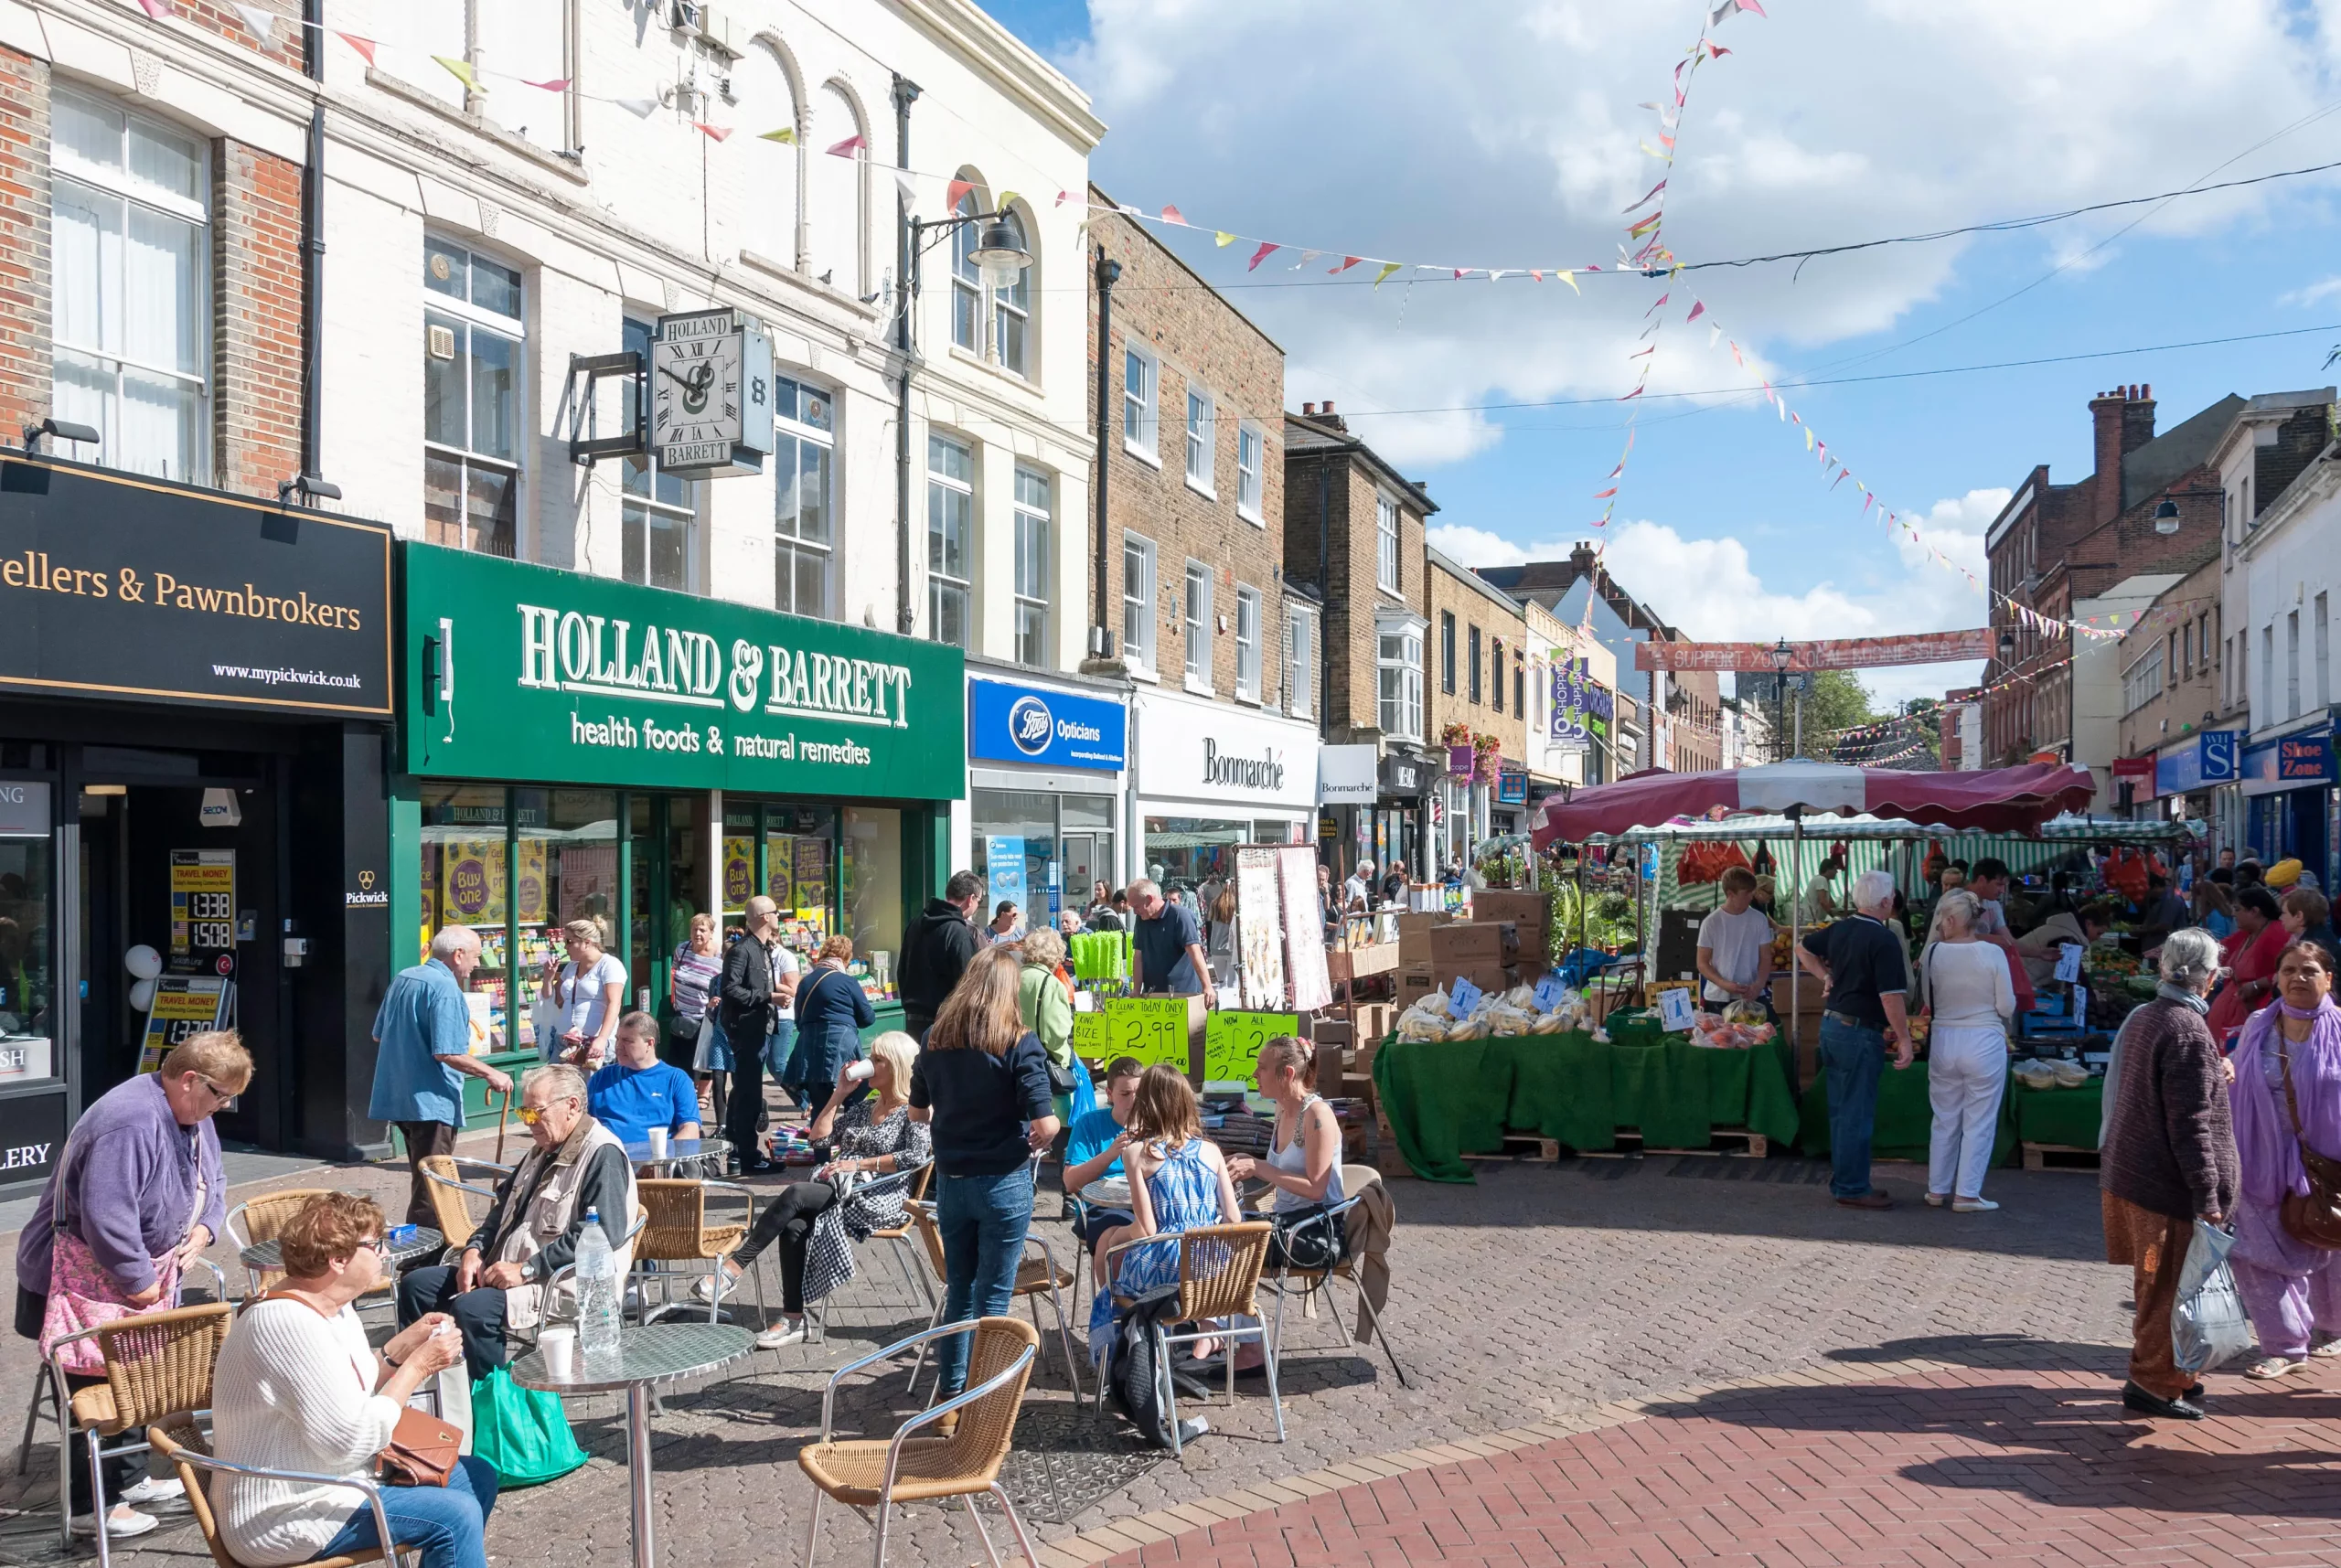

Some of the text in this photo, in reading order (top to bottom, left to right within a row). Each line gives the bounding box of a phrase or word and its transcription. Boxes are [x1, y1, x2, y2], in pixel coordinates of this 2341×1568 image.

[668, 317, 727, 341] HOLLAND
[668, 442, 727, 465] BARRETT
[0, 550, 361, 632] ellers & Pawnbrokers
[1673, 640, 1951, 669] SUPPORT YO LOCAL BUSINESSES
[517, 603, 913, 730] HOLLAND & BARRETT
[212, 663, 362, 689] www.mypickwick.co.uk
[1020, 709, 1100, 741] Boots Opticians
[570, 711, 871, 765] health foods & natural remedies
[2206, 733, 2228, 744] WH
[2282, 741, 2322, 758] Shoe
[1203, 737, 1285, 791] Bonmarché
[1450, 763, 1469, 772] cope
[2206, 743, 2230, 777] S
[2282, 759, 2322, 777] Zone
[1322, 783, 1373, 793] Bonmarché
[454, 806, 491, 822] HOLLAND
[726, 814, 753, 826] HOLLAND
[176, 869, 228, 878] TRAVEL MONEY
[457, 871, 481, 889] Buy
[729, 869, 746, 884] Buy
[732, 881, 746, 895] one
[194, 893, 230, 918] 1.338
[346, 891, 388, 904] Pickwick
[459, 891, 482, 905] one
[194, 923, 230, 948] 1.508
[160, 996, 216, 1006] TRAVEL MONEY
[1116, 1001, 1135, 1011] CLEAR
[1164, 1002, 1184, 1014] ONLY
[1078, 1015, 1095, 1025] KING
[1224, 1015, 1265, 1026] NOW ALL
[1075, 1025, 1098, 1040] SIZE
[1107, 1018, 1177, 1054] £2.99
[0, 1143, 51, 1170] ERY
